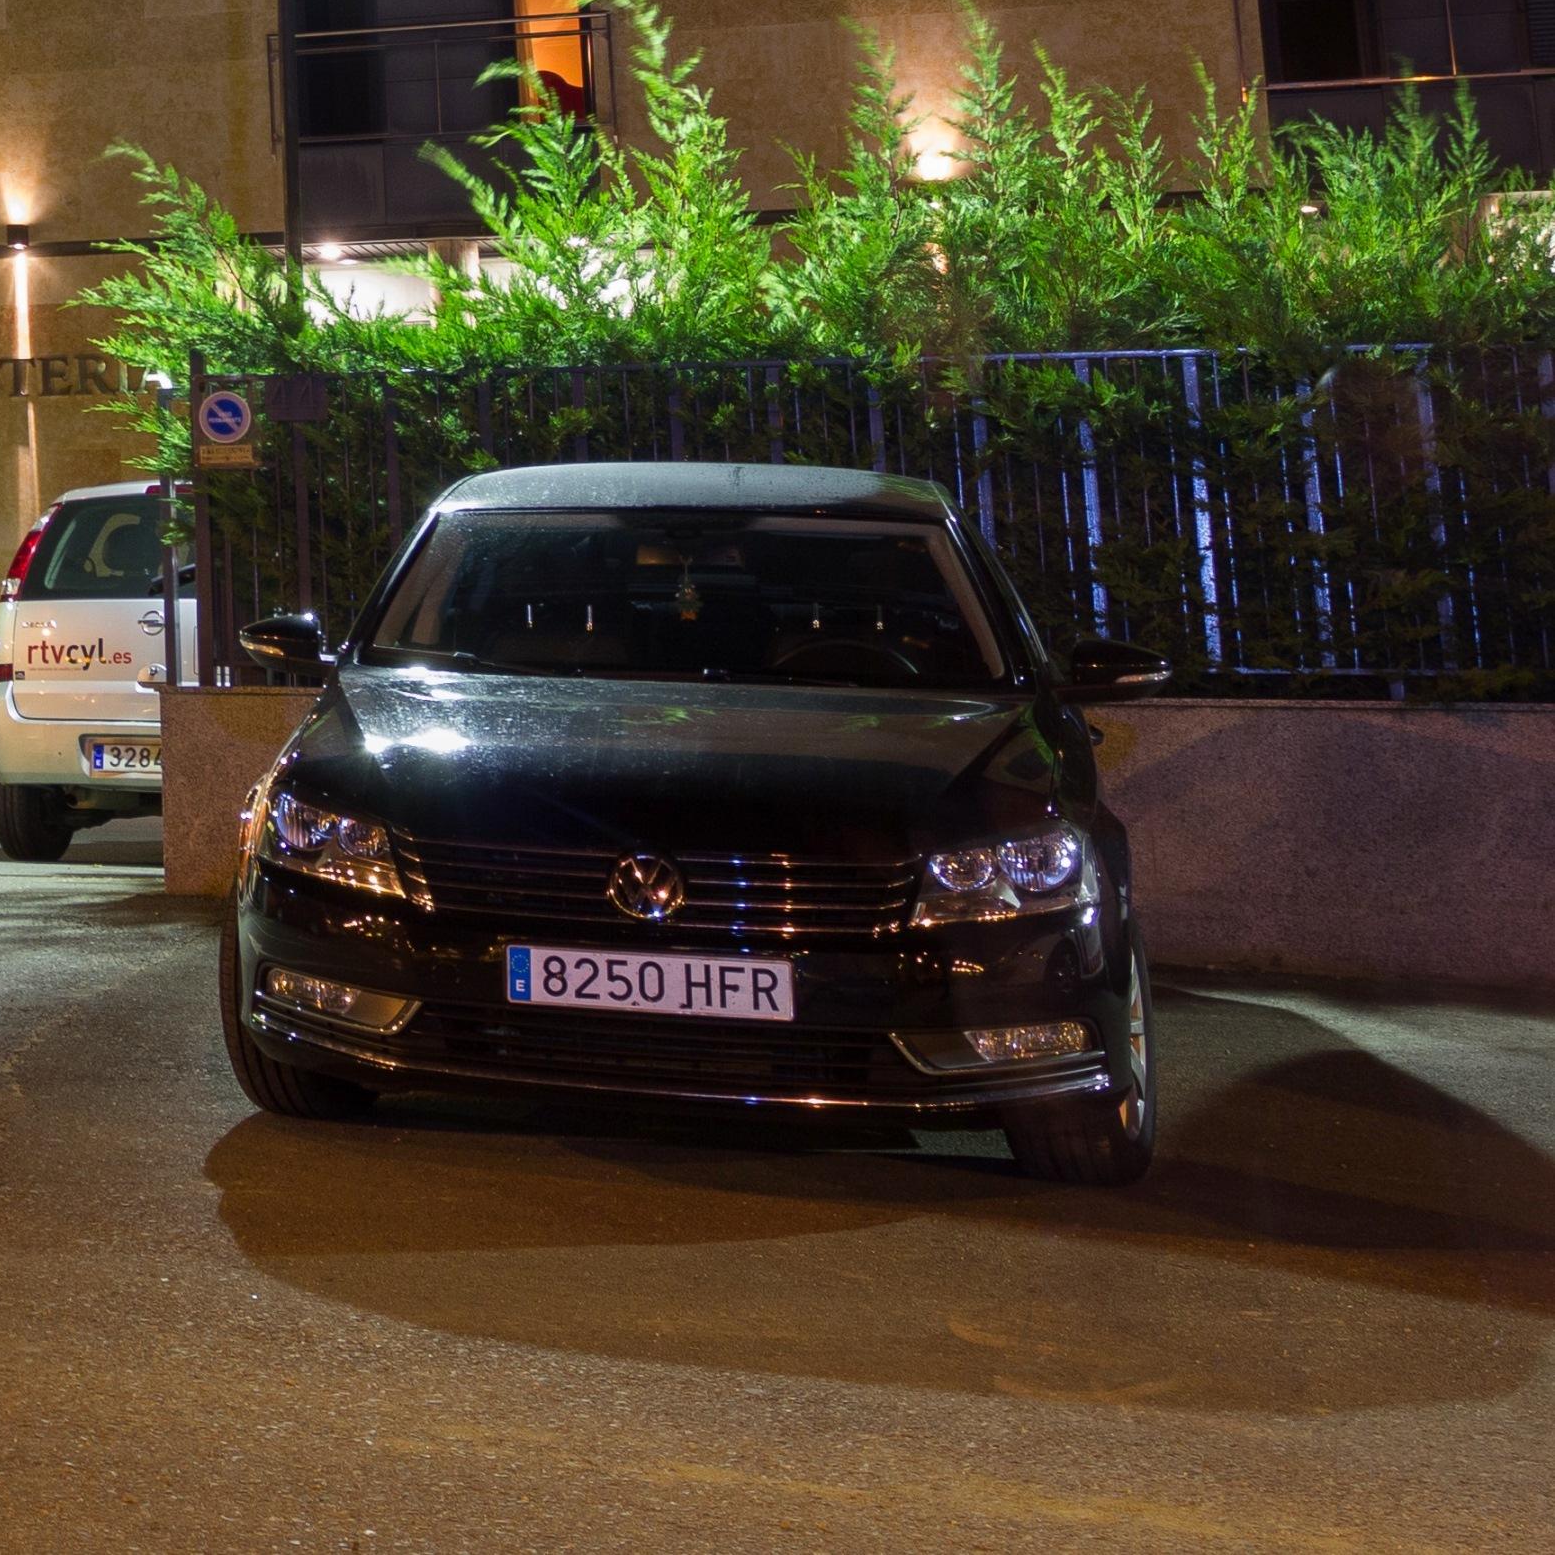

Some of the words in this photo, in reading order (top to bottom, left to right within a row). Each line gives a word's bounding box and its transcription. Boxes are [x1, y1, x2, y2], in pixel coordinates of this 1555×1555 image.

[27, 637, 132, 671] rtvcyl.es
[515, 979, 525, 992] E
[542, 955, 665, 1003] 8250
[684, 962, 780, 1012] HFR
